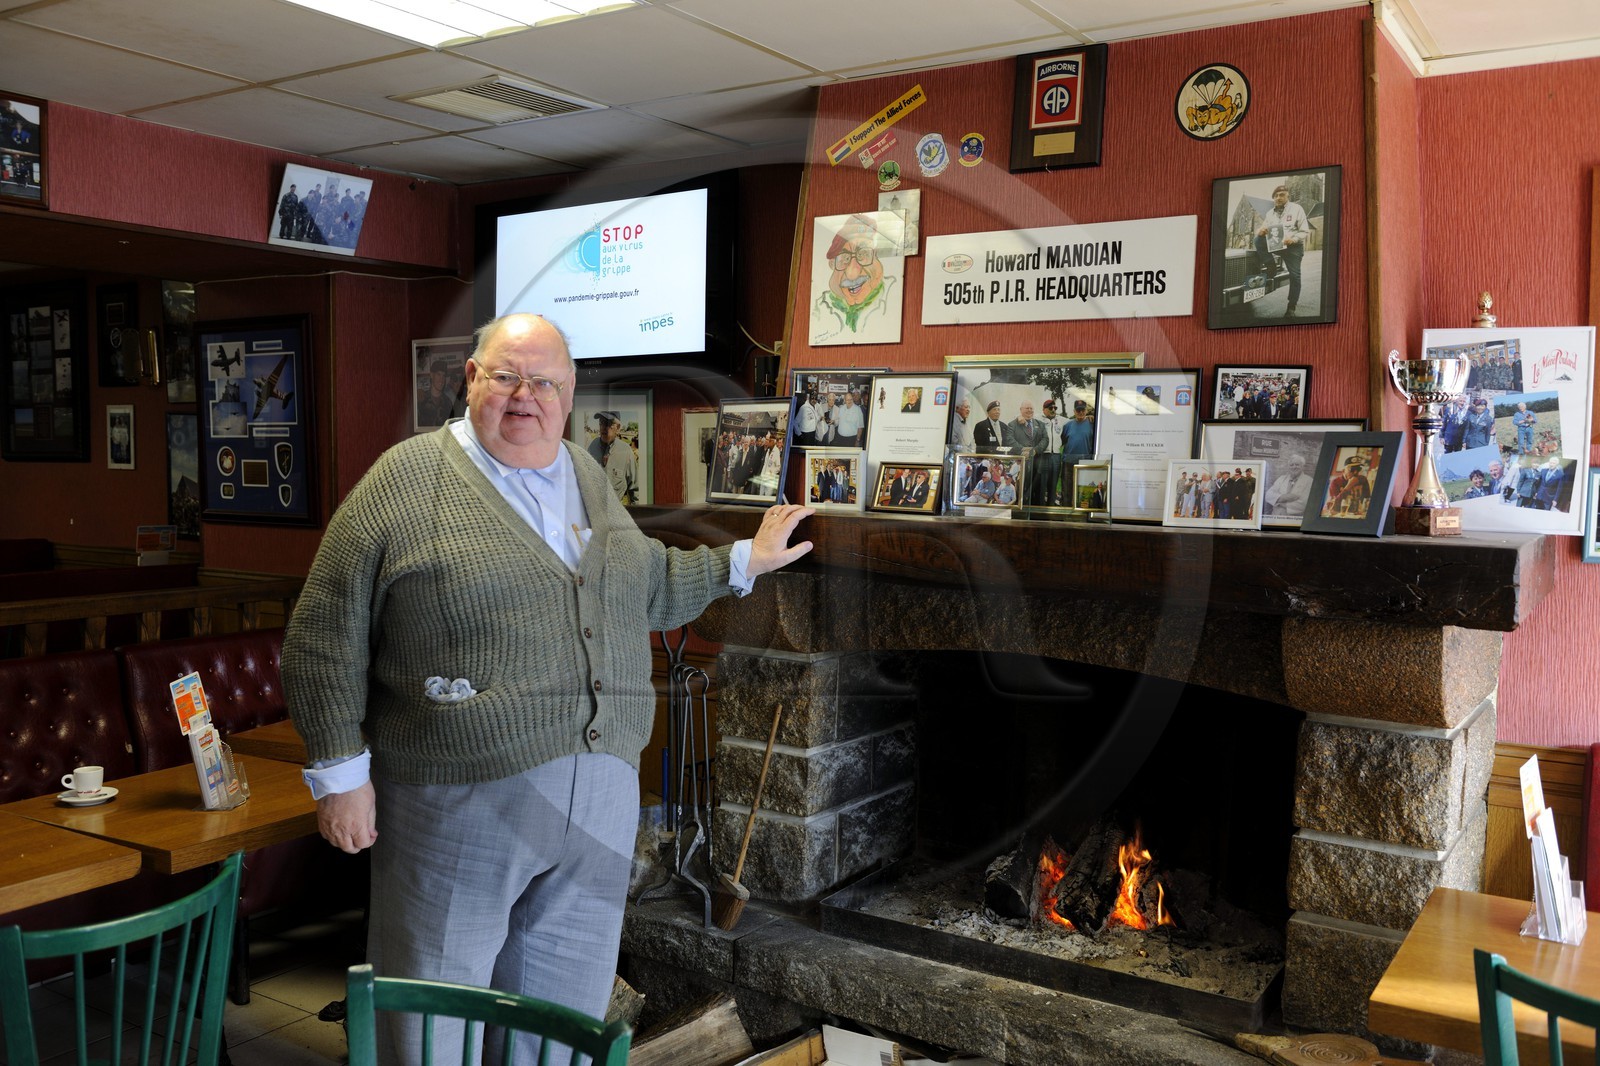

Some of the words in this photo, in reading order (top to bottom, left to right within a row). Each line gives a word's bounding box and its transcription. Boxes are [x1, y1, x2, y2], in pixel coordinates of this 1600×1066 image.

[1040, 63, 1076, 77] AIRBORNE
[852, 122, 876, 143] Support
[874, 115, 886, 128] The
[885, 102, 904, 119] Allied
[902, 91, 922, 108] Forces
[602, 224, 643, 243] STOP
[602, 244, 616, 253] aux
[619, 241, 643, 252] virus
[602, 254, 611, 264] de
[614, 254, 624, 263] la
[985, 246, 1041, 274] Howard
[1046, 240, 1122, 269] MANOIAN
[602, 264, 631, 277] grippe
[943, 282, 984, 306] 505th
[990, 279, 1030, 303] P.I.R.
[1035, 269, 1166, 302] HEADQUARTERS
[554, 289, 639, 303] www.pandemie-grippale.gouv.fr
[639, 316, 674, 332] inpes
